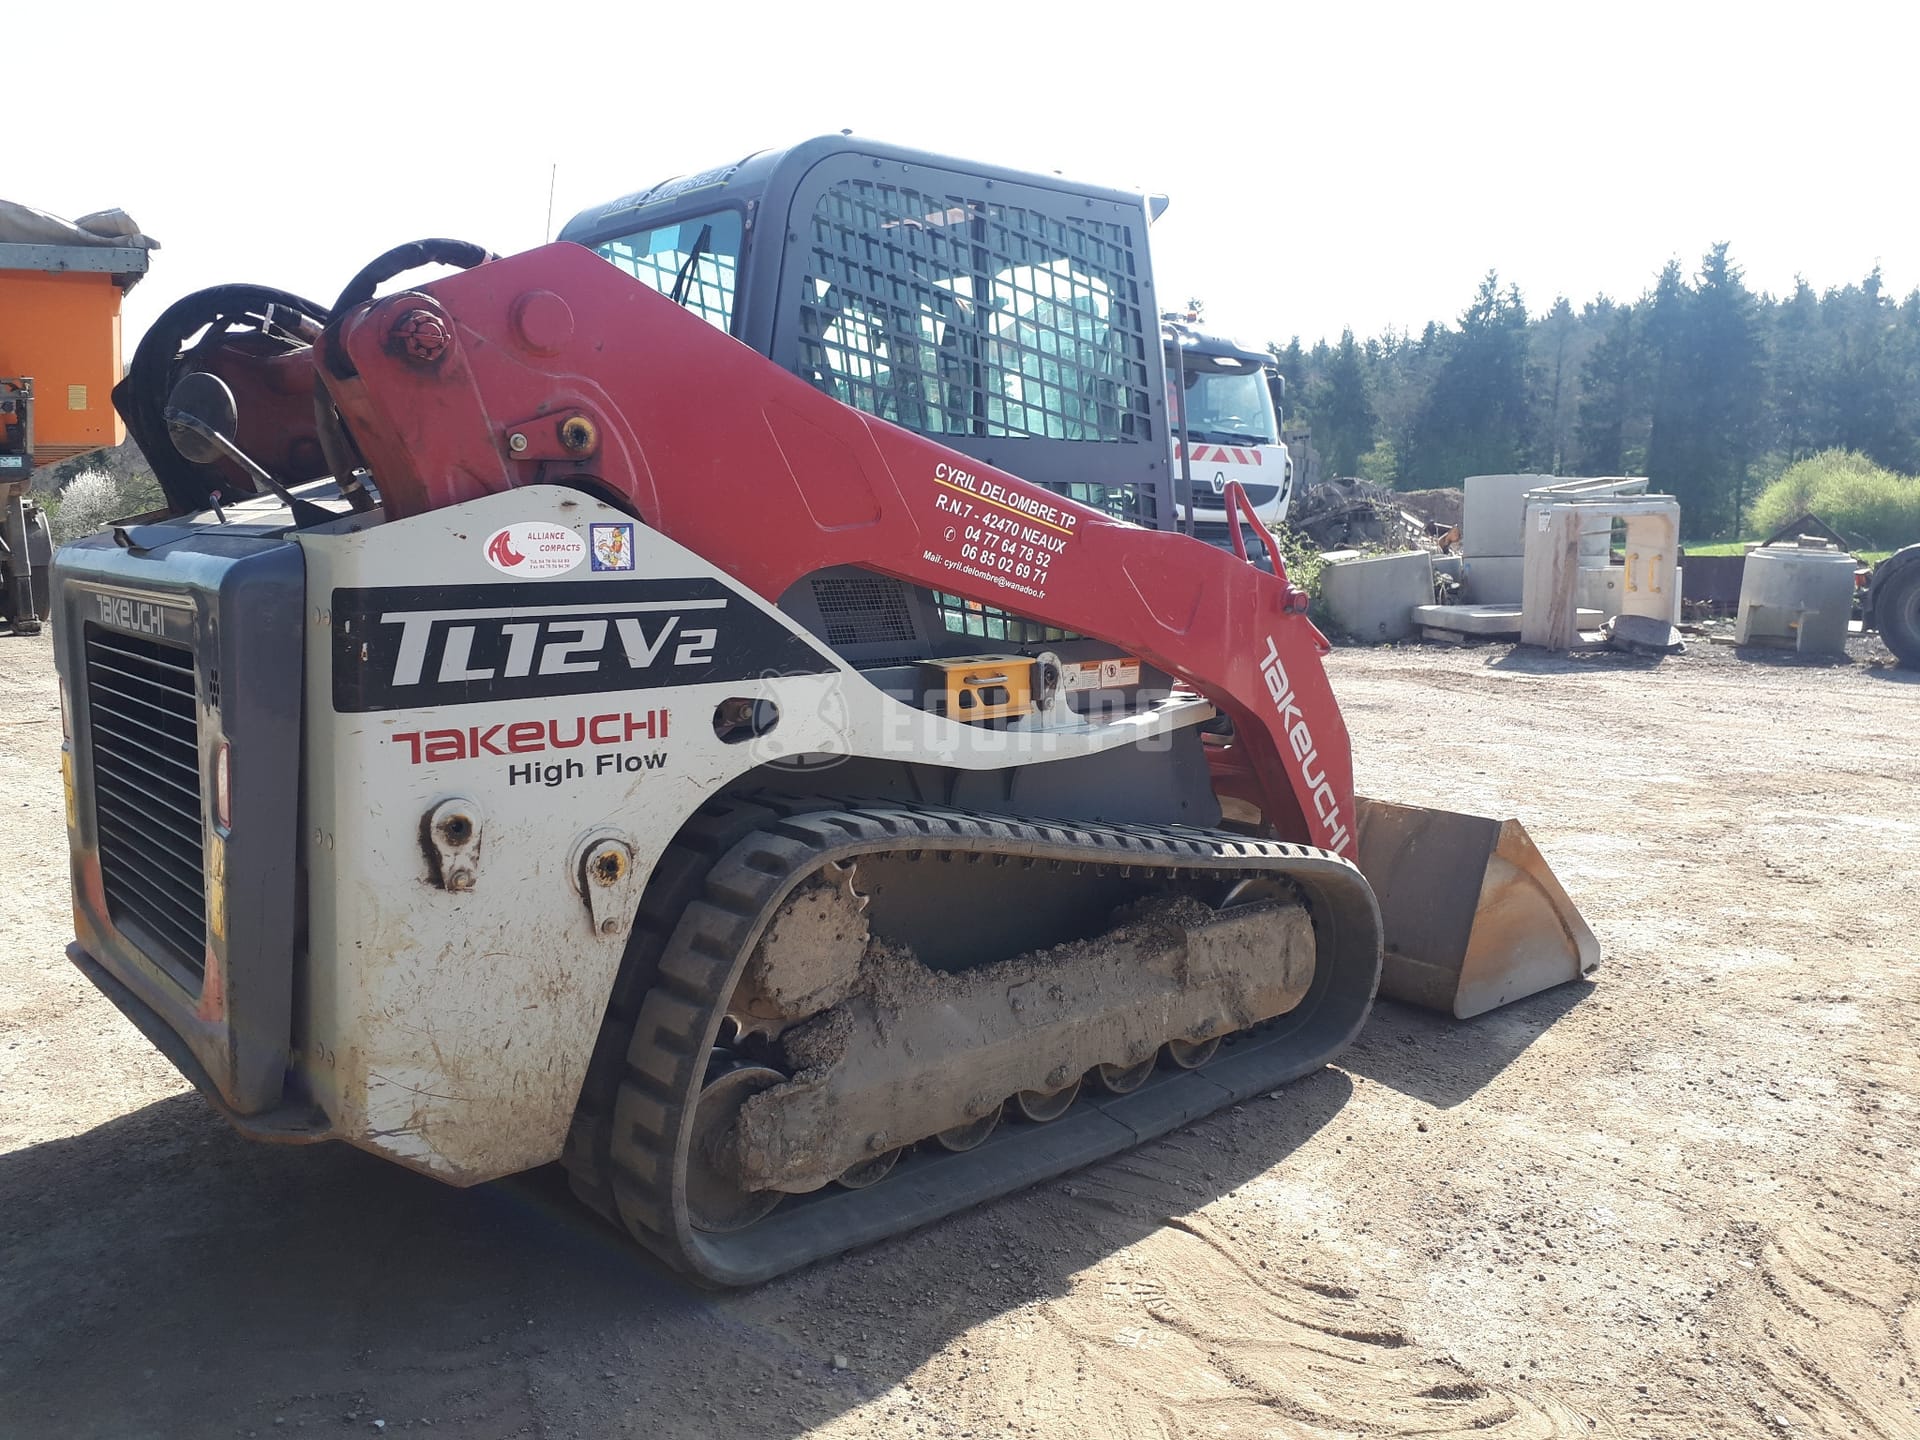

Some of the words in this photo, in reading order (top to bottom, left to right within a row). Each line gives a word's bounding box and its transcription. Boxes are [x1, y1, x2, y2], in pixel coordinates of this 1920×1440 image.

[935, 462, 977, 491] CYRIL
[980, 480, 1076, 528] DELOMBRE.TP
[527, 532, 565, 540] ALLIANCE
[935, 494, 973, 518] R.N.7
[982, 512, 1020, 536] 42470
[1020, 526, 1067, 554] NEAUX
[539, 544, 581, 552] COMPACTS
[961, 543, 978, 560] 06
[980, 550, 996, 566] 85
[998, 556, 1014, 573] 02
[1015, 562, 1031, 579] 69
[1032, 568, 1048, 585] 71
[965, 525, 981, 542] 04
[983, 532, 999, 548] 77
[1001, 539, 1017, 555] 64
[1019, 545, 1034, 561] 78
[1035, 551, 1051, 568] 52
[923, 550, 943, 565] Mail:
[944, 559, 1046, 599] cyril.delombre@wanadoo.fr
[509, 758, 584, 787] High
[596, 753, 668, 776] Flow
